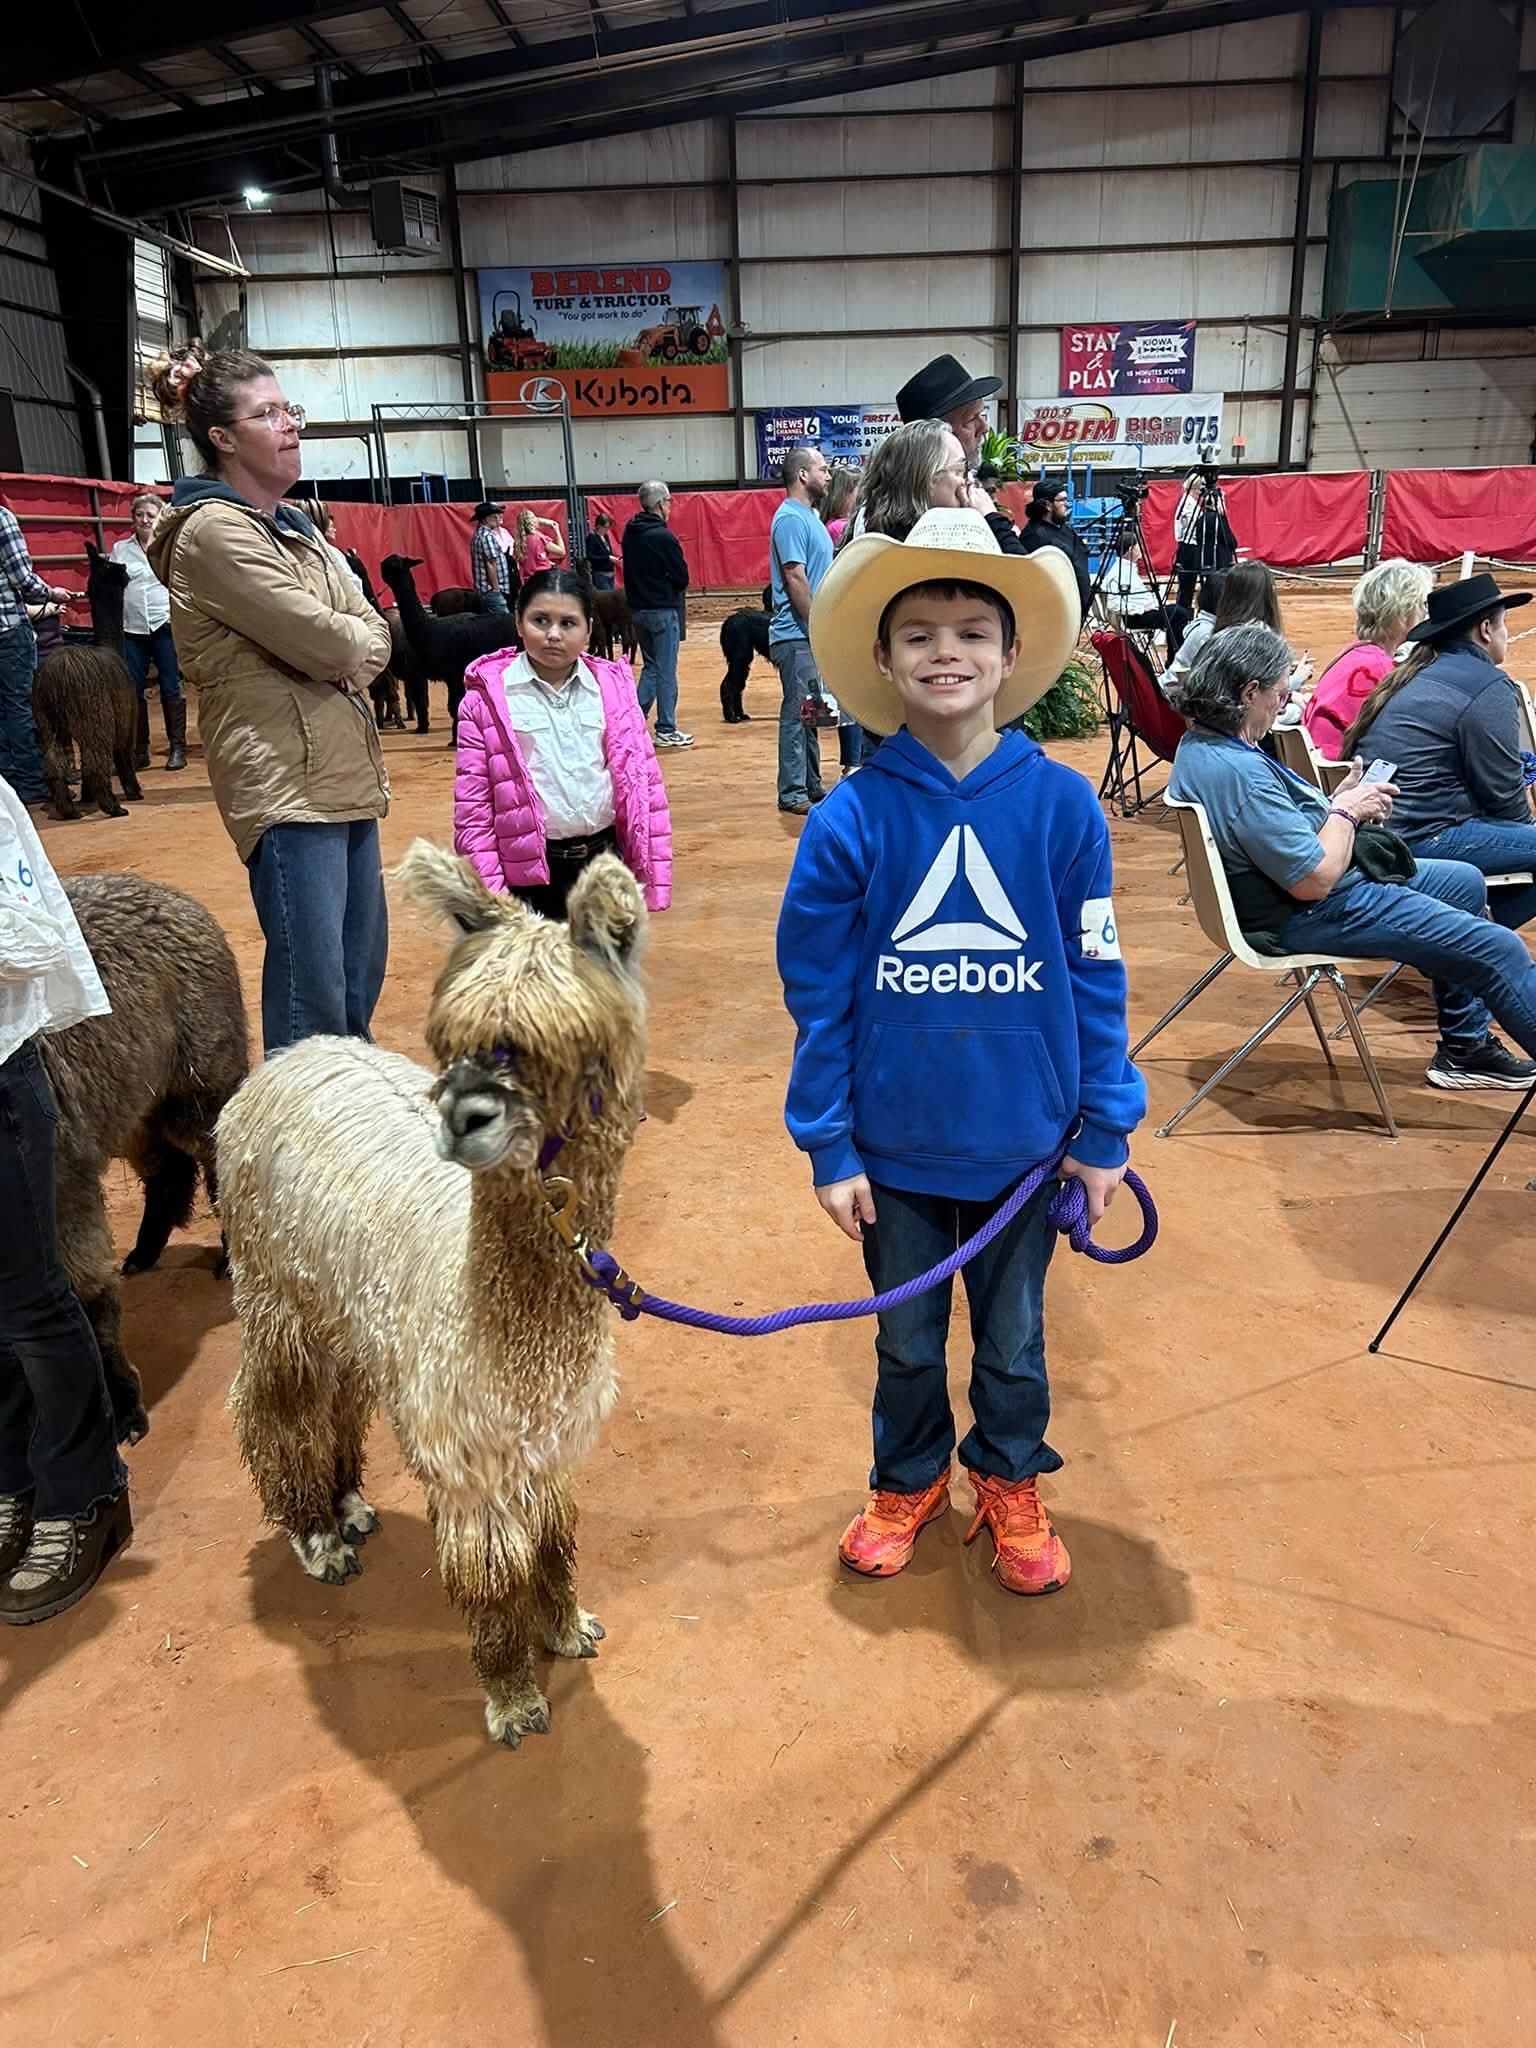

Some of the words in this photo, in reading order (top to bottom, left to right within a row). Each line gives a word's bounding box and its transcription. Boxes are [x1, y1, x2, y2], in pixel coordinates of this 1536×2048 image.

[530, 268, 671, 297] BEREND
[533, 297, 575, 310] TURF
[579, 296, 591, 309] &
[593, 294, 672, 308] TRACTOR
[558, 311, 578, 321] "You
[581, 311, 596, 322] got
[597, 310, 618, 320] work
[621, 310, 630, 319] to
[631, 309, 648, 319] do"
[1070, 332, 1121, 353] STAY
[1143, 338, 1173, 346] KIOWA
[1086, 352, 1103, 370] &
[1163, 367, 1186, 375] NORTH
[1069, 369, 1120, 390] PLAY
[575, 376, 692, 407] Kubota
[831, 415, 860, 424] YOUR
[861, 414, 891, 423] FIRST
[1035, 406, 1073, 419] 100.9
[776, 419, 803, 429] NEWS
[806, 415, 818, 435] 6
[863, 425, 901, 435] BREAK
[1022, 418, 1080, 442] BOB
[1079, 417, 1119, 442] FM
[1126, 416, 1163, 432] BIG
[1183, 416, 1219, 444] 97.5
[832, 439, 862, 449] NEWS
[864, 438, 872, 448] &
[1126, 431, 1182, 446] COUNTRY
[767, 446, 791, 455] FIRST
[18, 860, 33, 888] 6
[1102, 915, 1116, 944] 6
[875, 953, 1044, 995] Reebok
